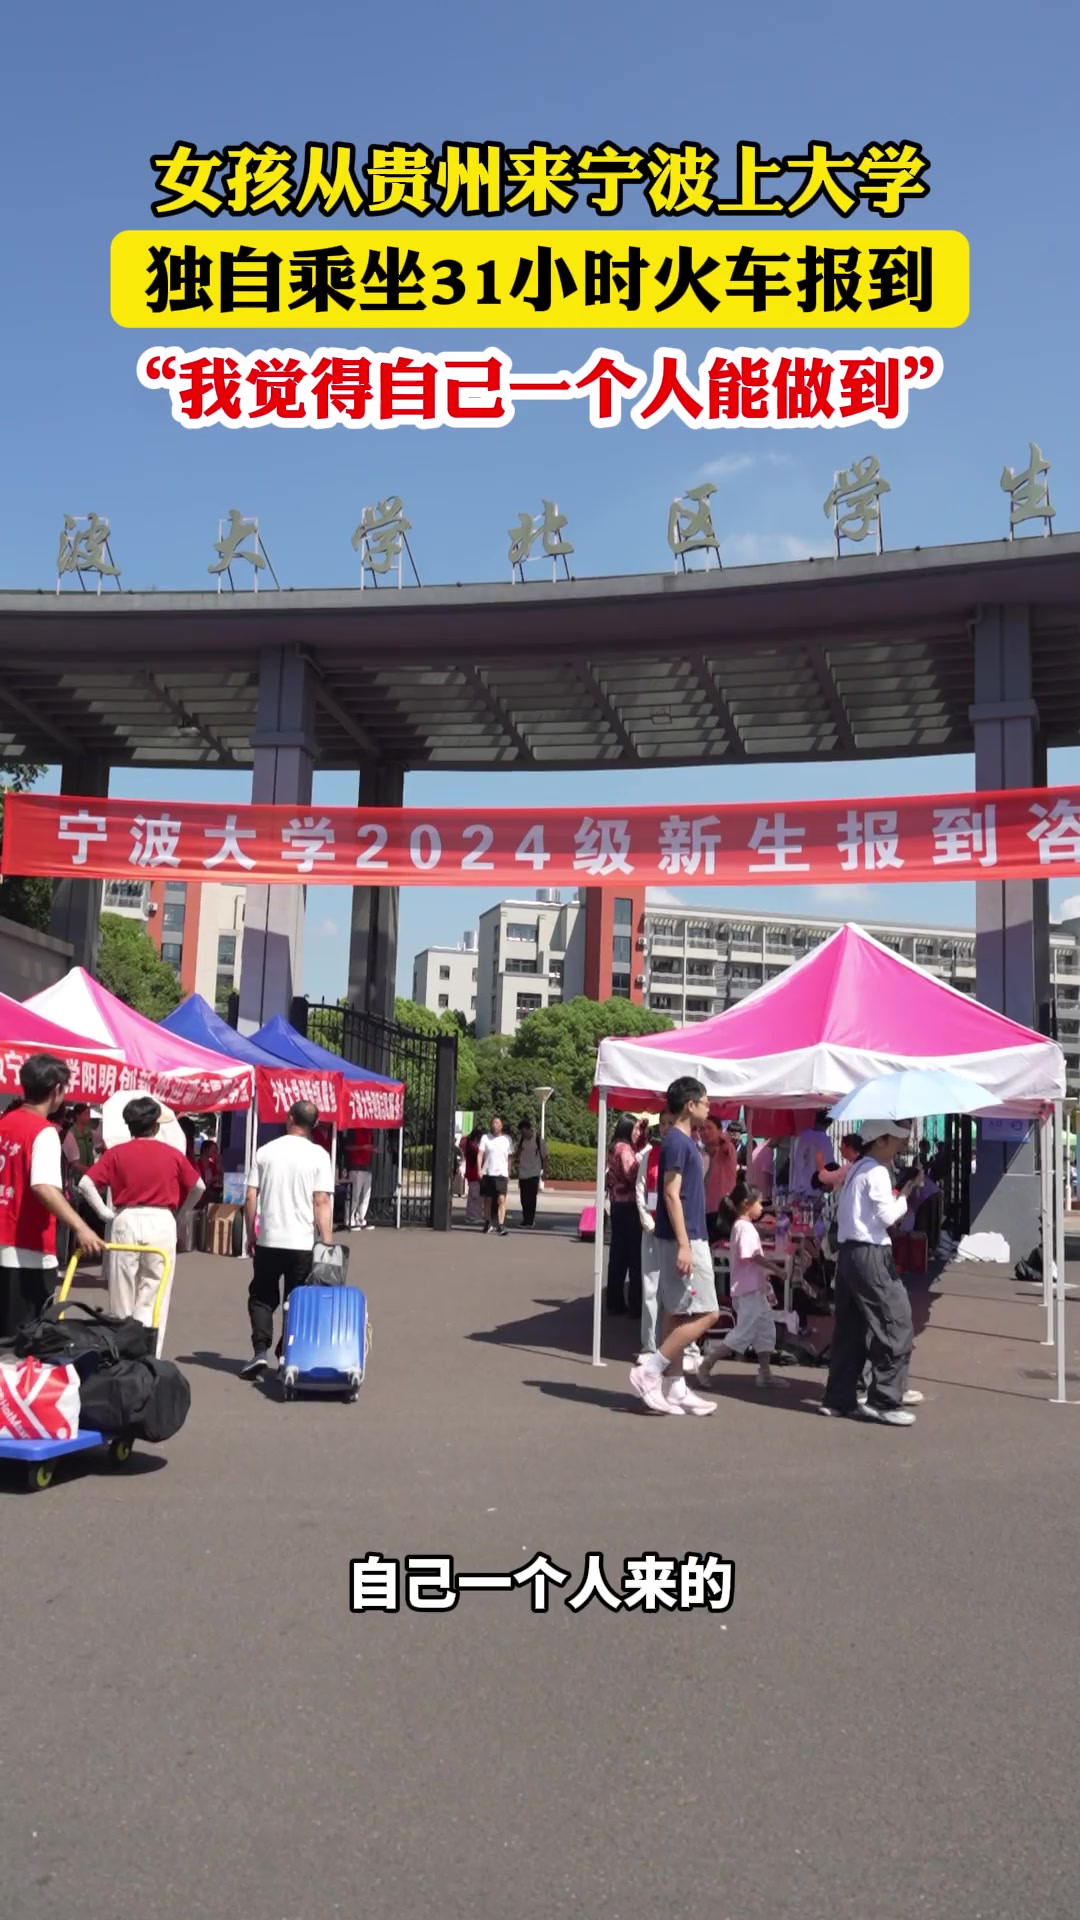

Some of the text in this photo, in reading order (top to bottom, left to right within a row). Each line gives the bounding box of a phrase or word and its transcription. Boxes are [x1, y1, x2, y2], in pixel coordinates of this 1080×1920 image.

[57, 798, 1080, 877] 宁波大学2024级新生报到咨
